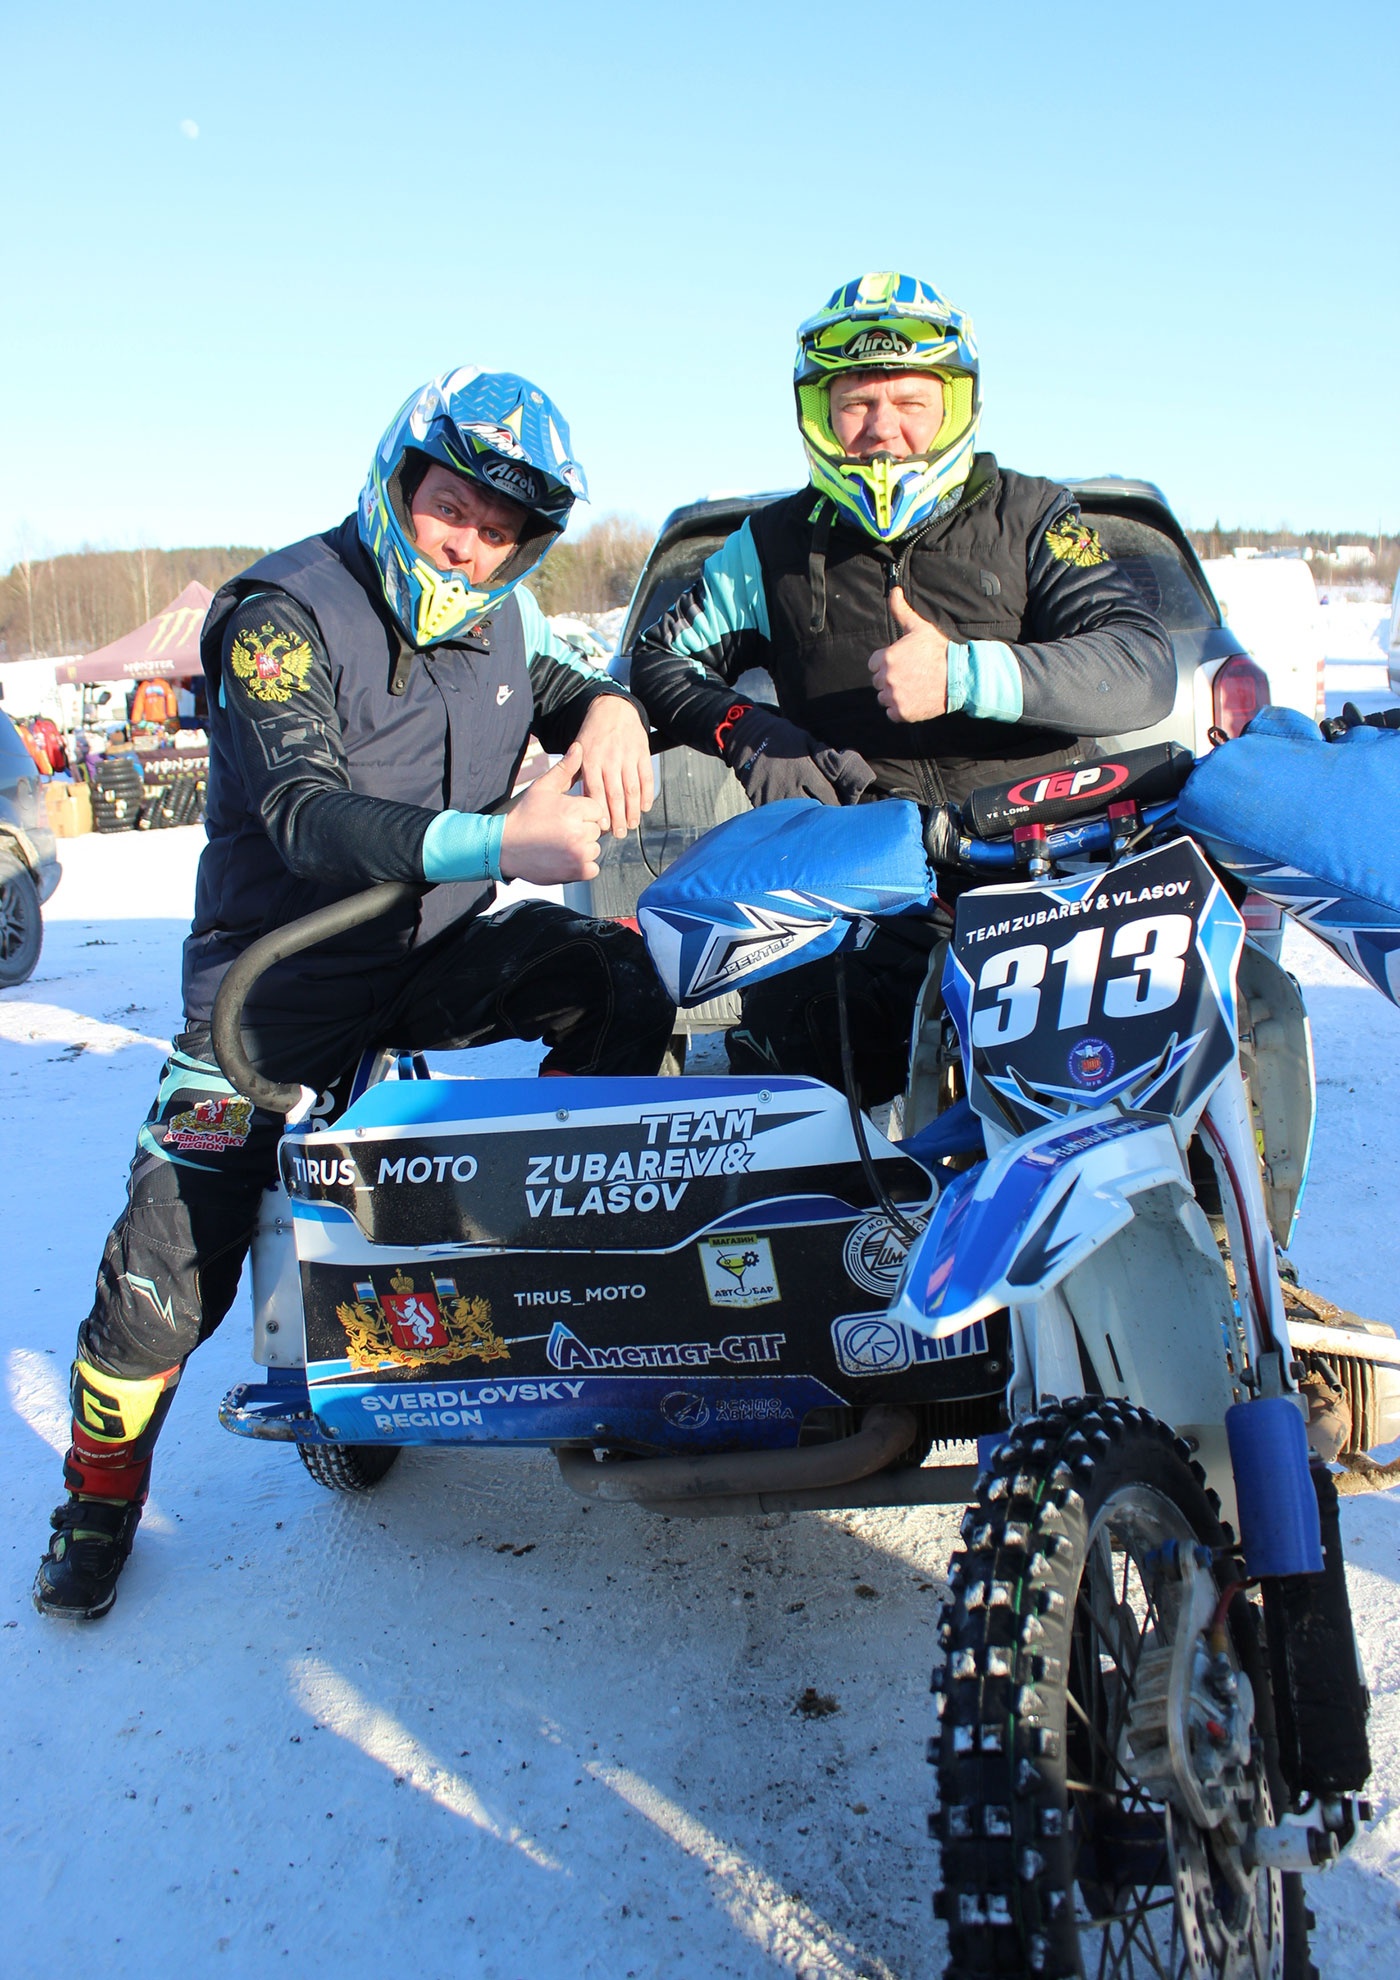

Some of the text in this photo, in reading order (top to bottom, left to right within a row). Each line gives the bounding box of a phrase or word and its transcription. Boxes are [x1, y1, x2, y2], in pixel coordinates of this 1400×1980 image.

[848, 332, 908, 354] Airoh
[488, 463, 535, 499] Airoh
[1033, 767, 1101, 802] IGP
[986, 805, 1030, 819] YE LONG
[966, 880, 1191, 944] TEAM ZUBAREV & VLASOV
[971, 914, 1193, 1048] 313
[641, 1108, 756, 1144] TEAM
[165, 1133, 245, 1146] SVERDLOVSKY
[179, 1142, 224, 1151] REGION
[525, 1181, 689, 1218] VLASOV
[712, 1237, 755, 1246] МАГАЗИН
[513, 1284, 647, 1307] TIRUS_MOTO
[360, 1381, 586, 1411] SVERDLOVSKY
[373, 1409, 484, 1429] REGION
[716, 1408, 795, 1421] АВИСМА
